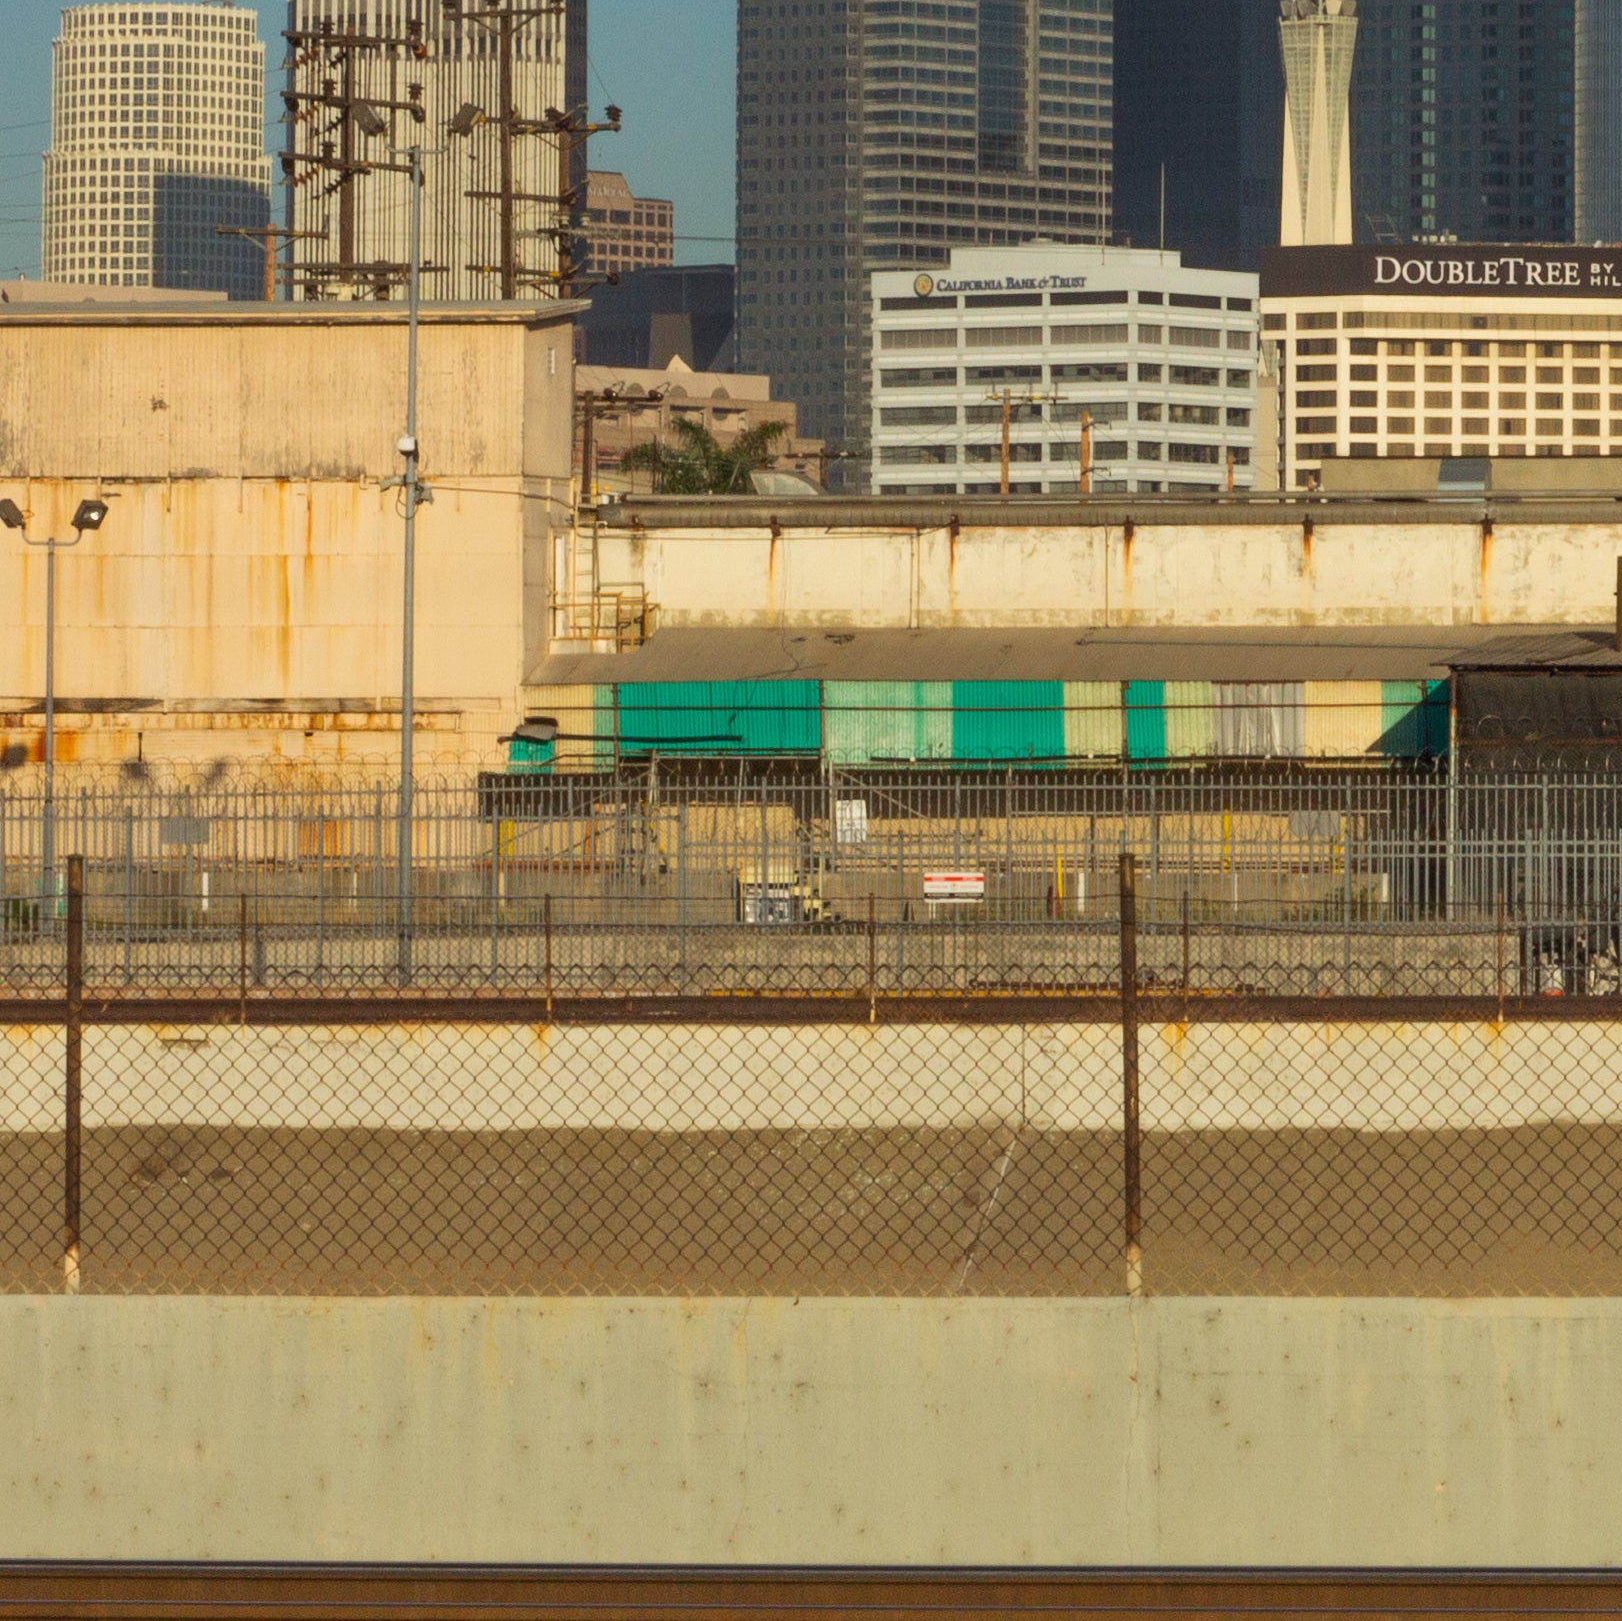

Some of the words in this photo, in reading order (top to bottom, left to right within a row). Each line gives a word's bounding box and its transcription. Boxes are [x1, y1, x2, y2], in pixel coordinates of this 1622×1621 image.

[1374, 256, 1581, 286] DOUBLETREE
[1590, 263, 1614, 274] BY
[936, 278, 1003, 292] CALIFORNIA
[1005, 276, 1038, 290] BANK
[1050, 274, 1087, 289] TRUST
